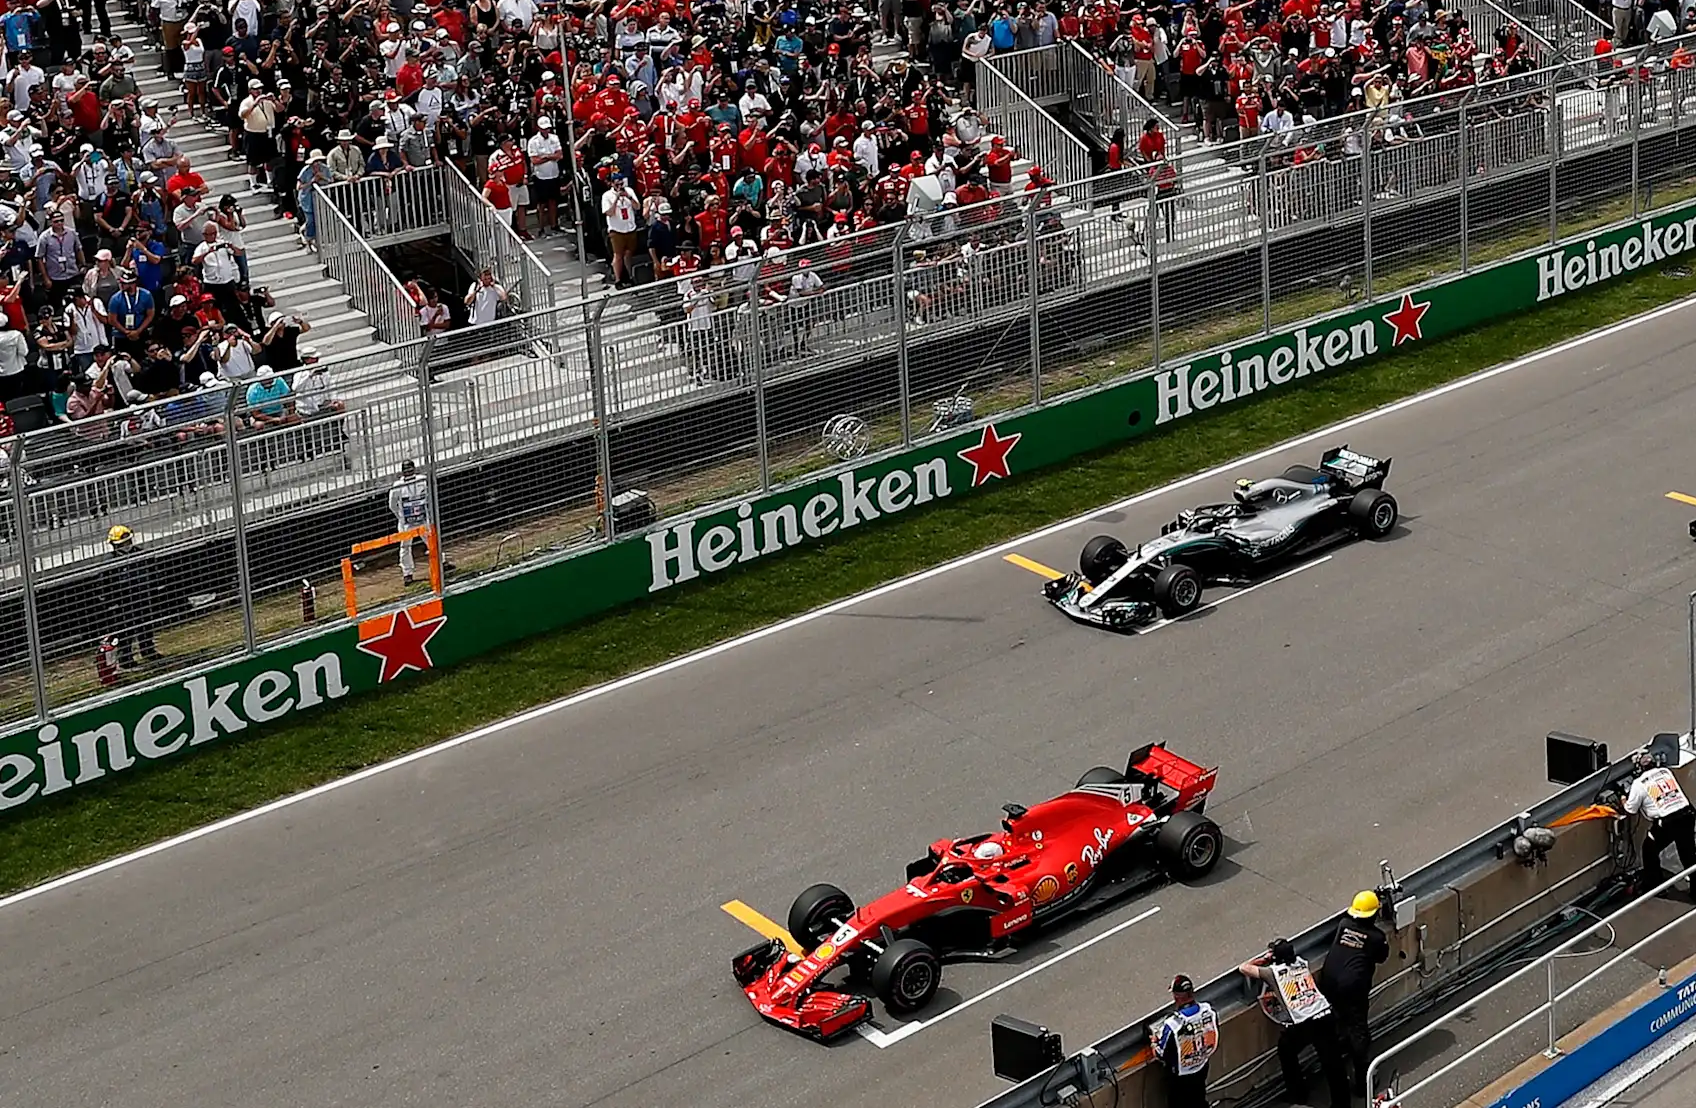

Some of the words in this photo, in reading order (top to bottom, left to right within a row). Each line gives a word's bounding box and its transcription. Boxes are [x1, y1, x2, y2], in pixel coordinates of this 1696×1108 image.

[1154, 317, 1379, 426] Heineken
[645, 455, 952, 594] Heineken
[836, 929, 851, 943] 5
[1003, 914, 1028, 930] Lenovo
